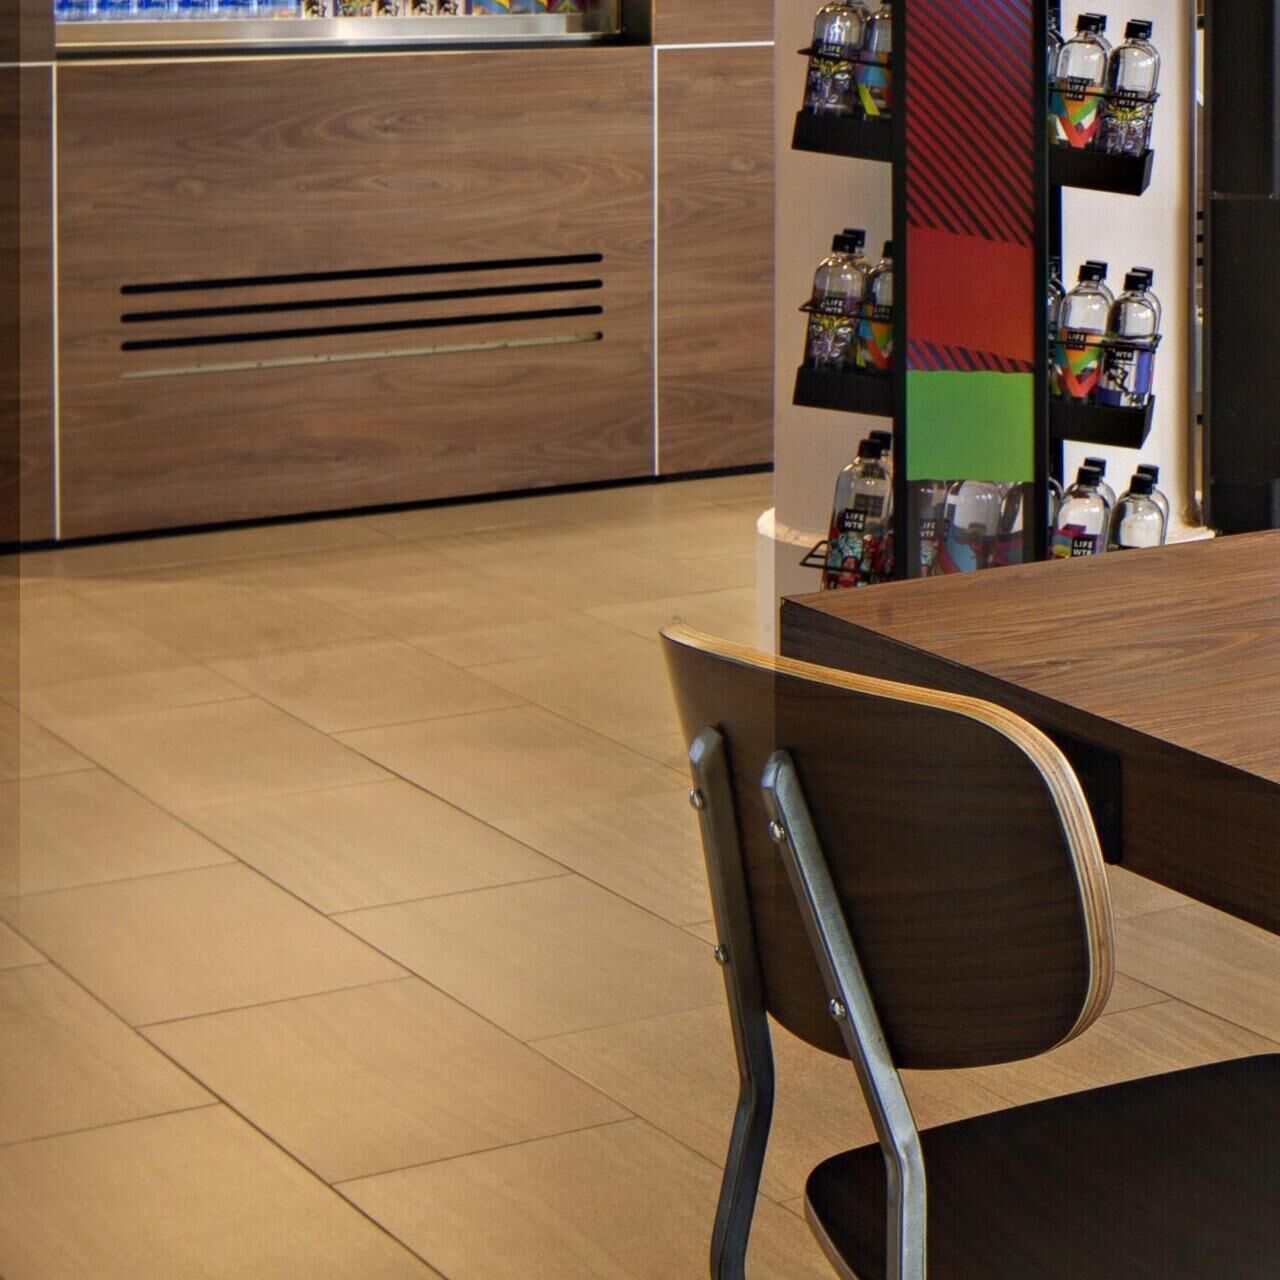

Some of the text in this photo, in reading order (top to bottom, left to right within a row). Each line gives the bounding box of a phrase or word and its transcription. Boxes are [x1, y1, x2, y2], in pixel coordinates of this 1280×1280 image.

[1066, 82, 1084, 93] LIFE
[1068, 333, 1085, 341] LIFE
[1115, 351, 1133, 359] WTR
[845, 511, 865, 521] LIFE
[844, 521, 864, 530] WTR
[1073, 540, 1094, 549] LIFE
[1072, 548, 1093, 557] WTR
